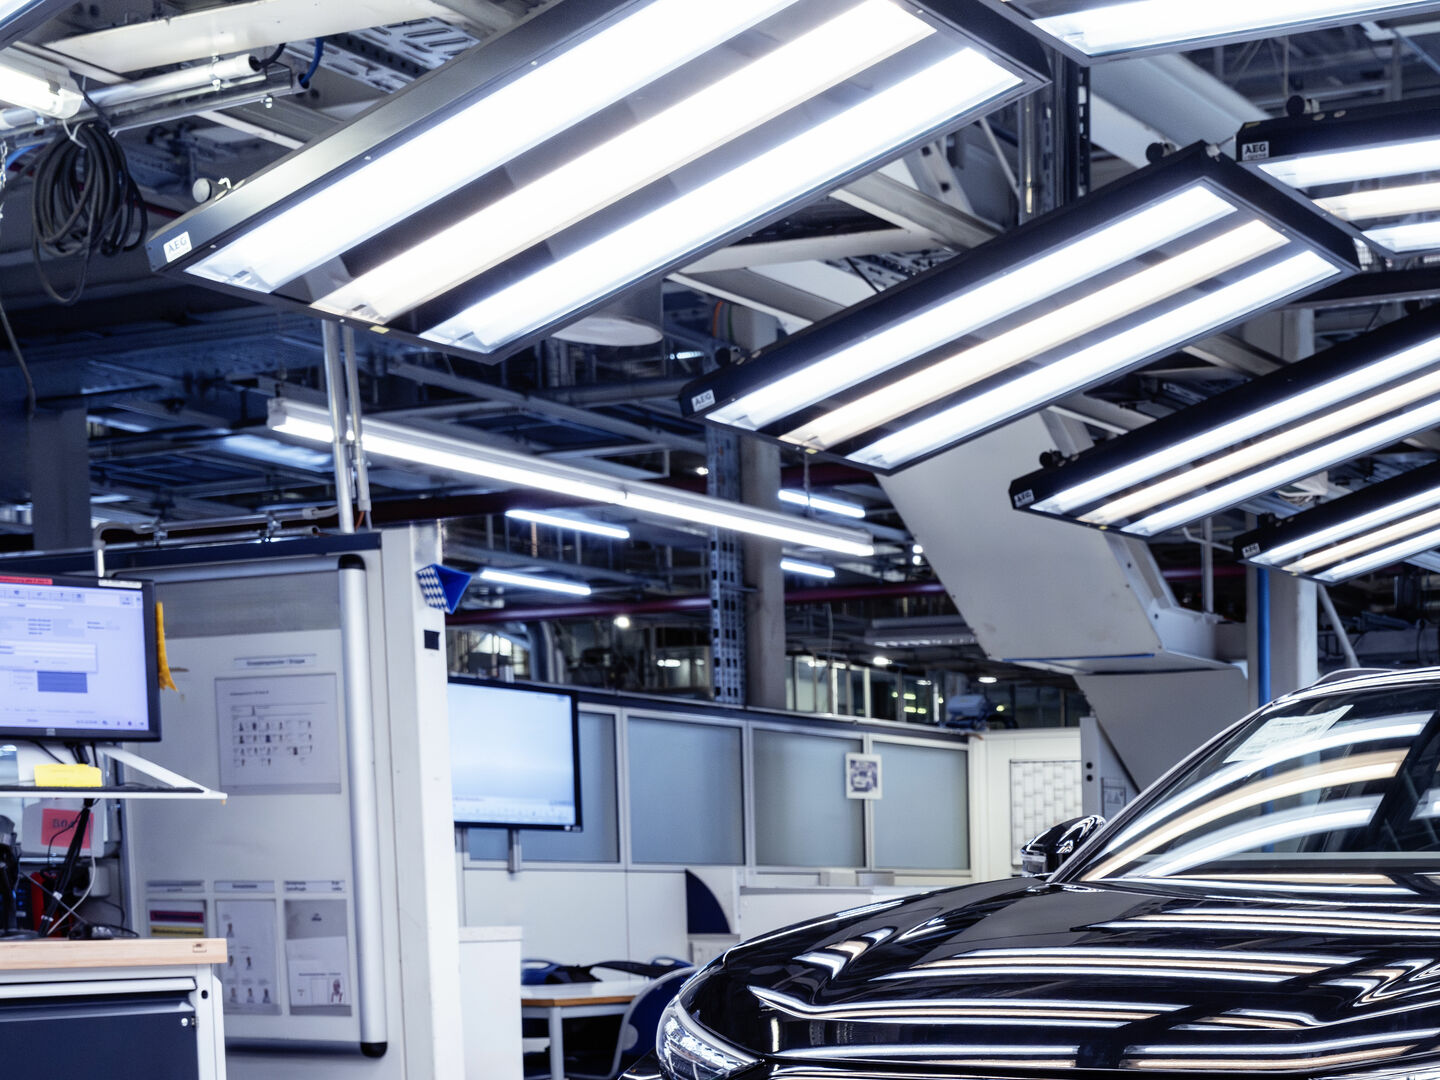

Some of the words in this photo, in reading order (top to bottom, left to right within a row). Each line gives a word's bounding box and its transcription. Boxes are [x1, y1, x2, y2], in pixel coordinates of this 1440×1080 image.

[1245, 144, 1266, 154] AEG
[168, 236, 187, 252] AEG
[694, 393, 711, 406] AEG
